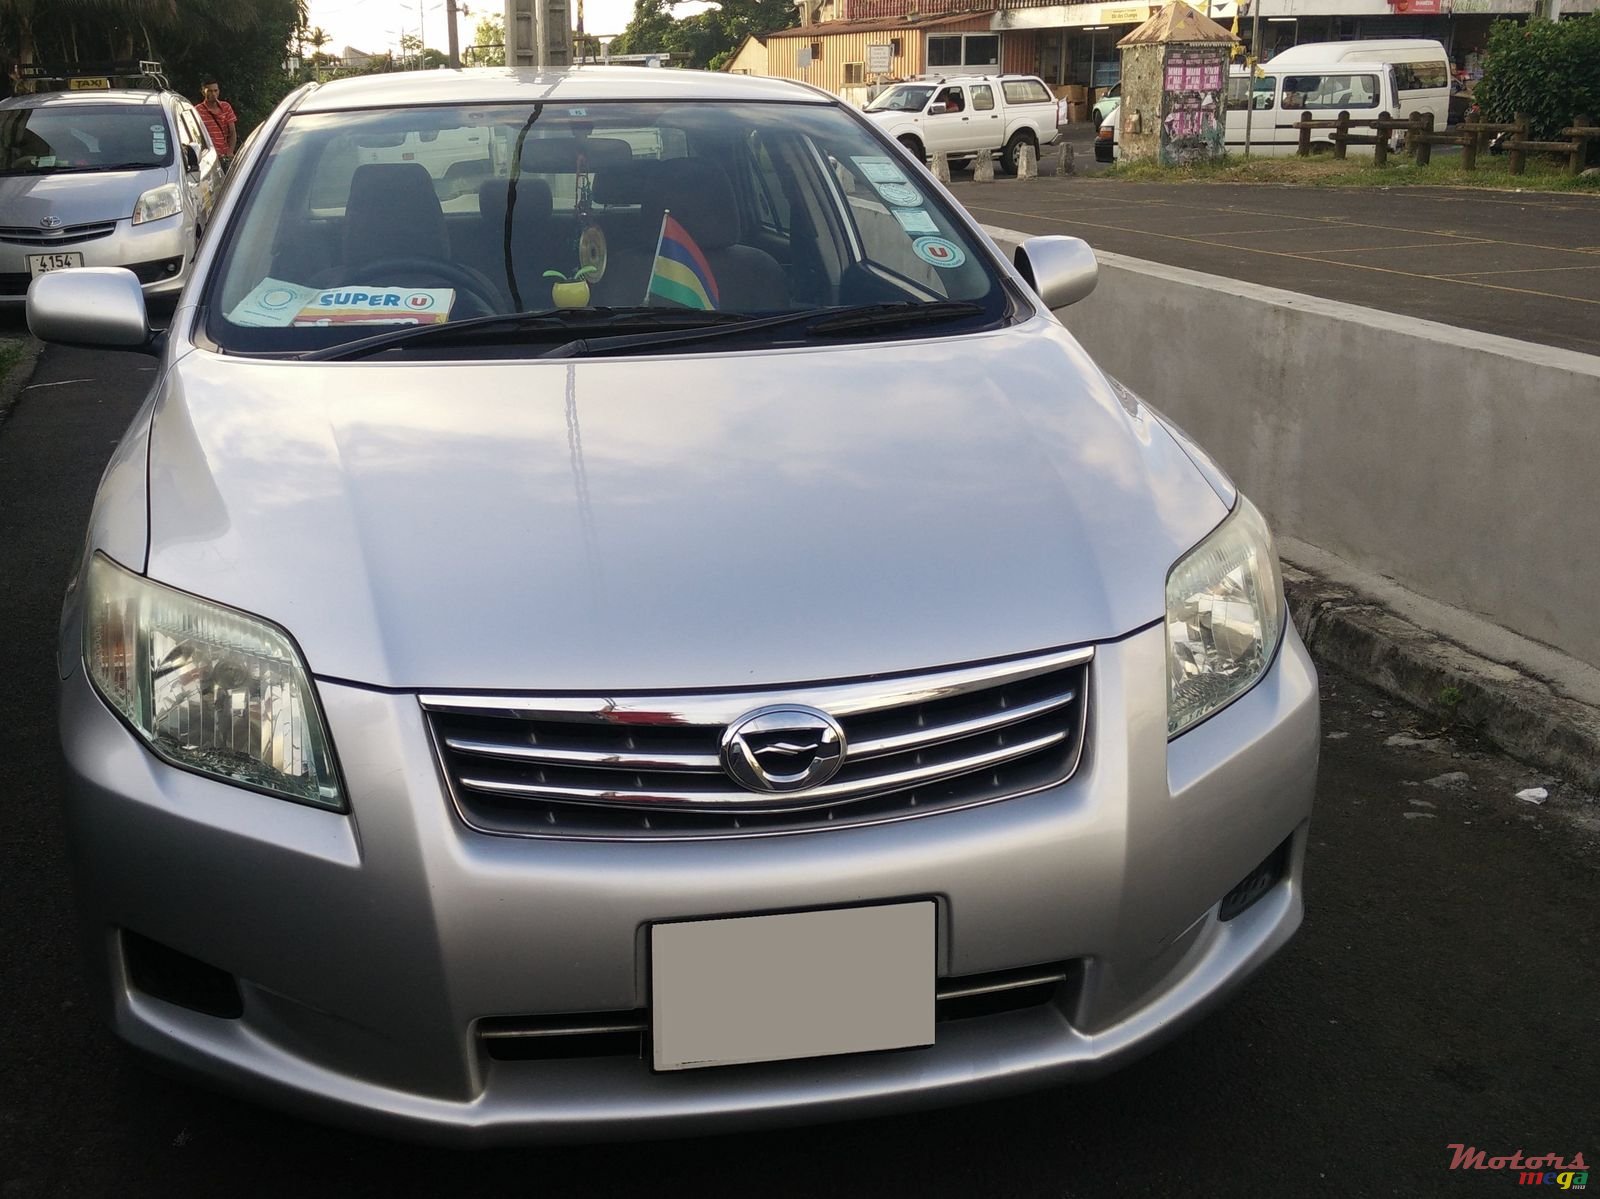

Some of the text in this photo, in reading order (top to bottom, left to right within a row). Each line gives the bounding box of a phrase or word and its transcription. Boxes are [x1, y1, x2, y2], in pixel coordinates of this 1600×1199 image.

[75, 79, 102, 89] TAXI
[928, 247, 948, 257] U
[40, 255, 71, 268] 4154
[318, 293, 427, 306] SUPER U
